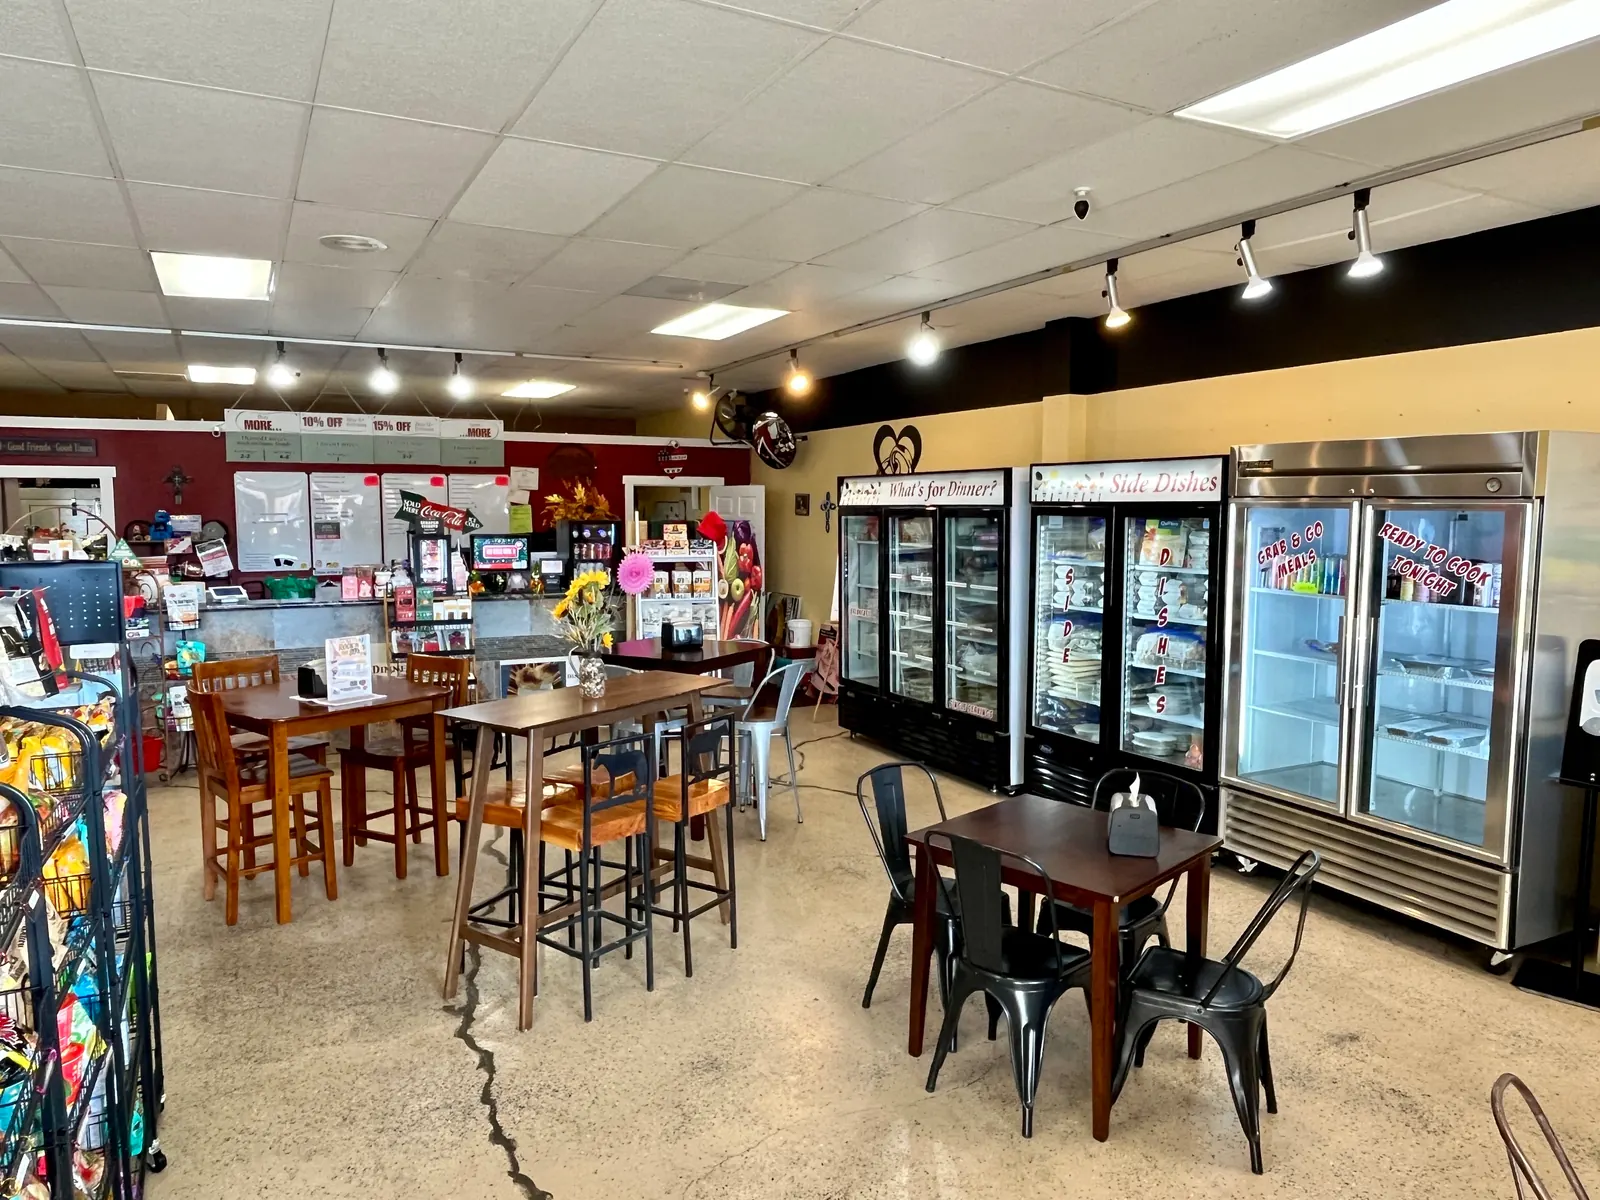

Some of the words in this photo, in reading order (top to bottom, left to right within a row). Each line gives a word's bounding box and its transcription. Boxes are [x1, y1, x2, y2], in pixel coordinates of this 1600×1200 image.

[302, 416, 324, 428] 10%
[326, 417, 343, 428] OFF
[373, 420, 394, 431] 15%
[396, 421, 412, 431] OFF
[889, 481, 924, 498] What's
[925, 480, 946, 502] for
[947, 479, 998, 497] Dinner?
[1110, 472, 1149, 494] Side
[1153, 470, 1218, 493] Dishes
[1257, 539, 1288, 565] GRAB
[1290, 532, 1302, 549] &
[1305, 520, 1324, 543] GO
[1379, 522, 1426, 553] READY
[1424, 544, 1448, 564] TO
[1446, 556, 1492, 587] COOK
[1276, 548, 1316, 579] MEALS
[1391, 555, 1458, 597] TONIGHT
[1063, 567, 1074, 664] SIDE
[1155, 547, 1171, 714] DISHES
